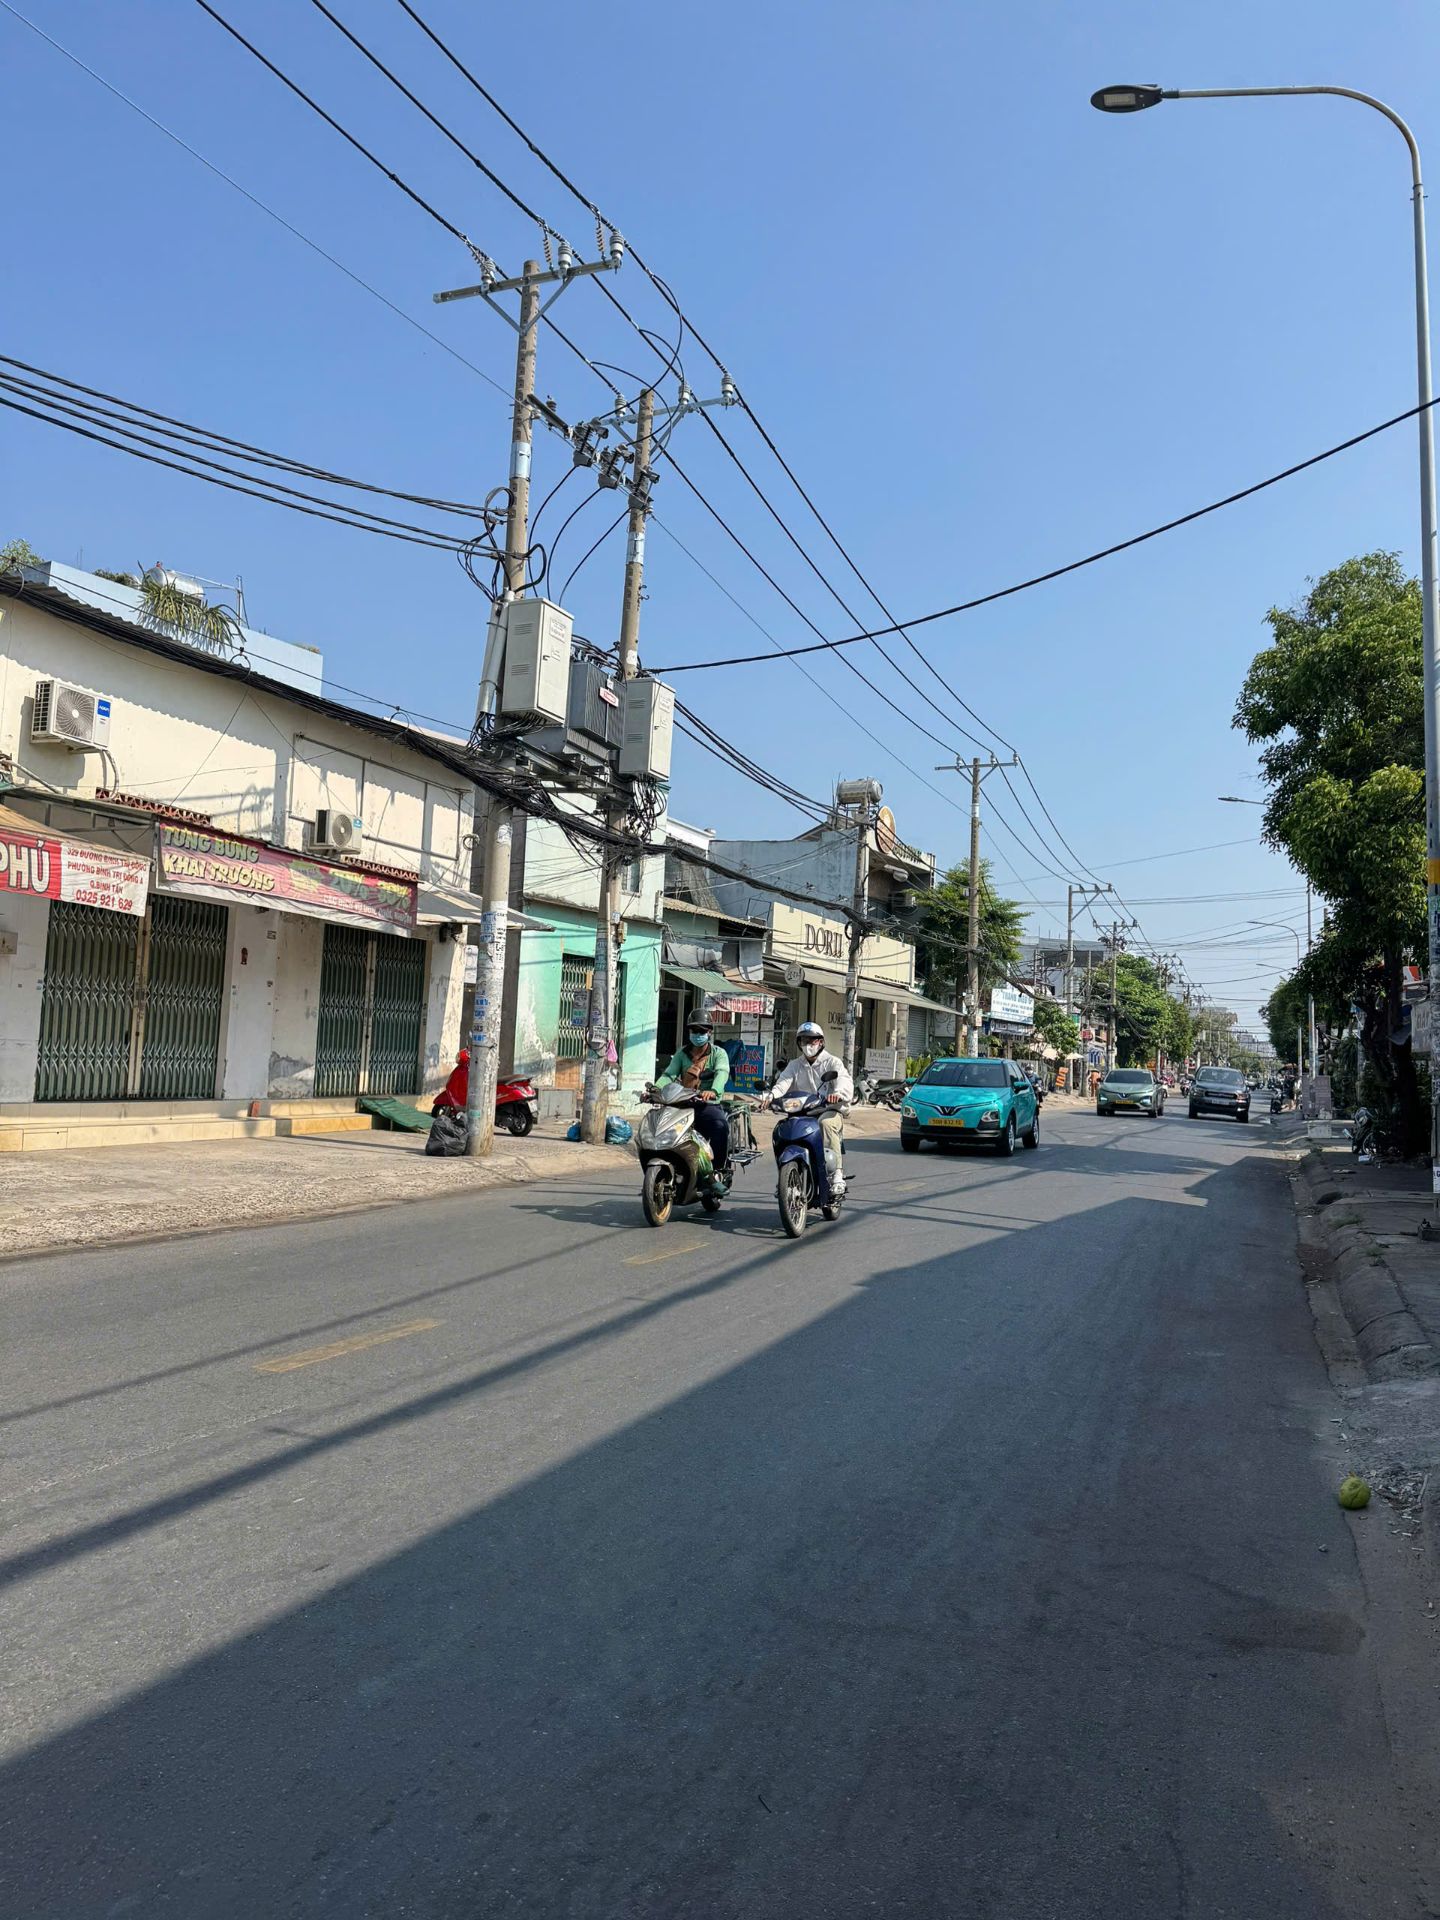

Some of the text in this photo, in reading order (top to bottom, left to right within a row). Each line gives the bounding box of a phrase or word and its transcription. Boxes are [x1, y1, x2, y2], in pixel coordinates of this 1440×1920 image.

[163, 853, 207, 880] KHAI
[75, 889, 133, 912] 0325 921 629
